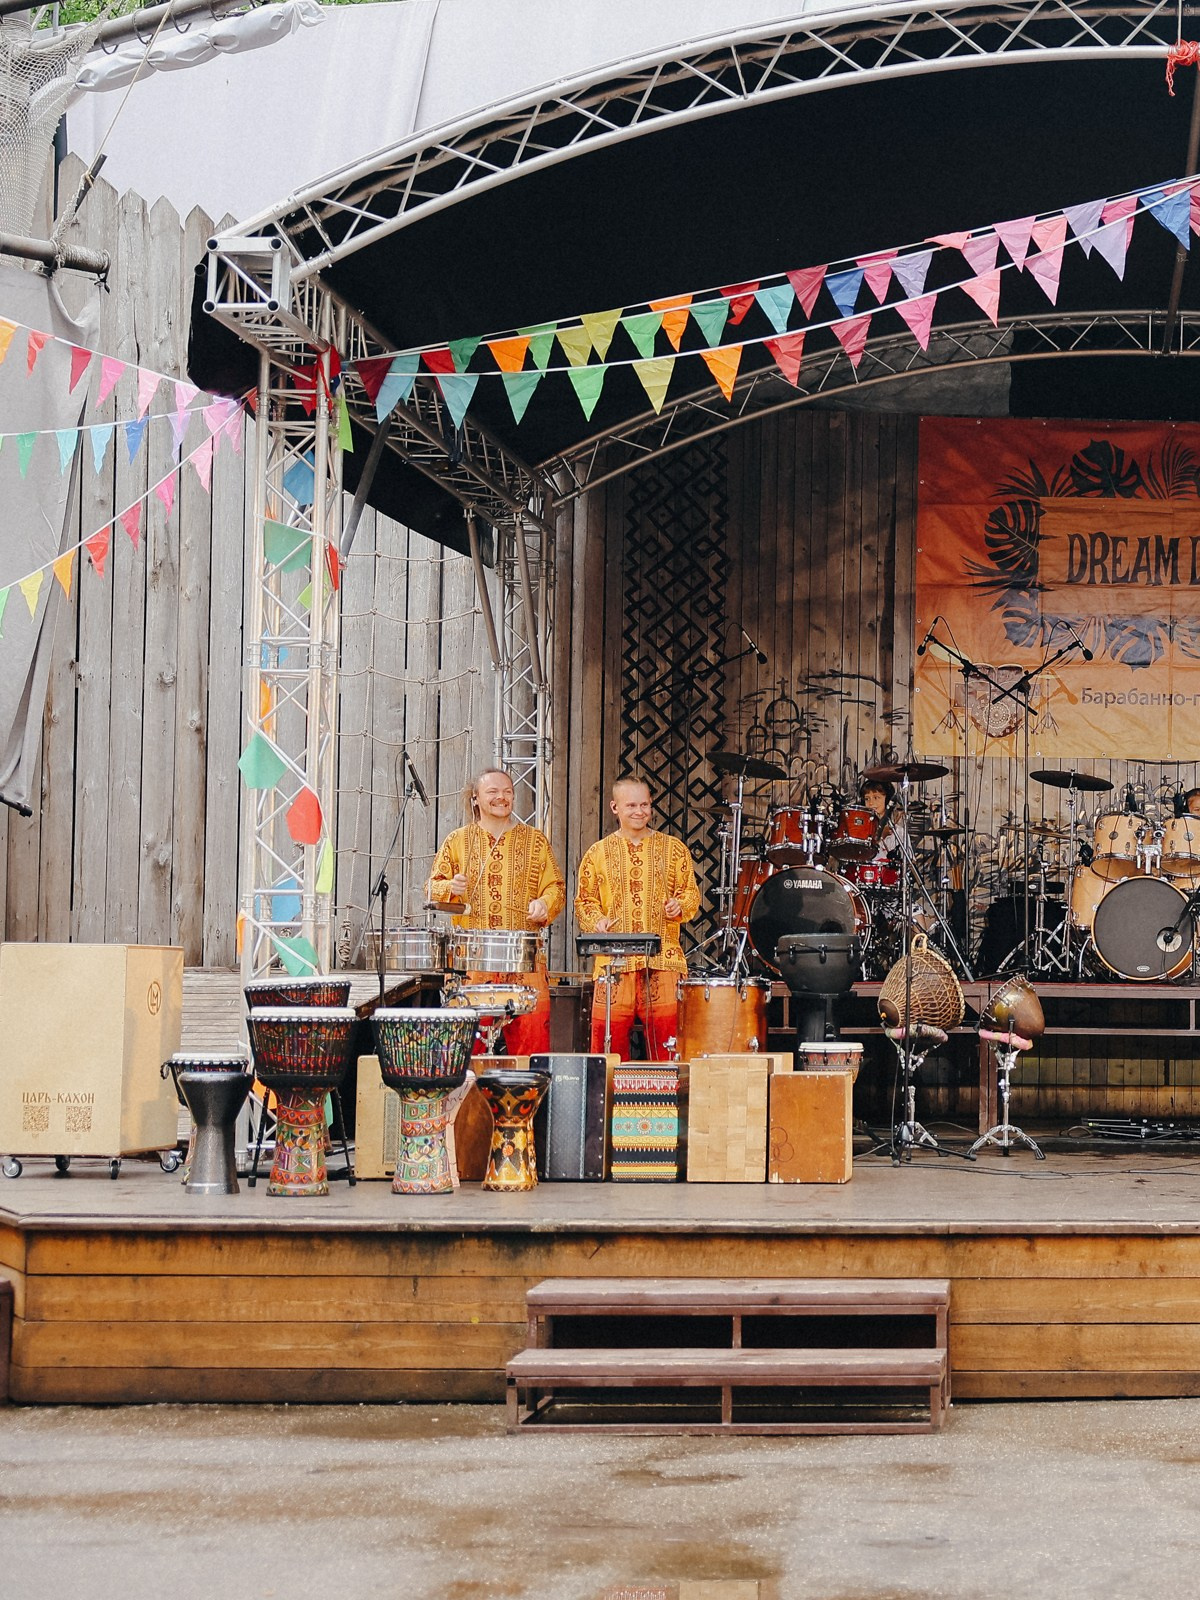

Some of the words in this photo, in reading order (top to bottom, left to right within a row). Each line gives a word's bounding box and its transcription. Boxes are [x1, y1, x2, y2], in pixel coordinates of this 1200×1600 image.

[1066, 531, 1181, 587] DREAM
[793, 879, 823, 889] YAMAHA
[22, 1092, 95, 1104] ЦАРЬ-КАХОН
